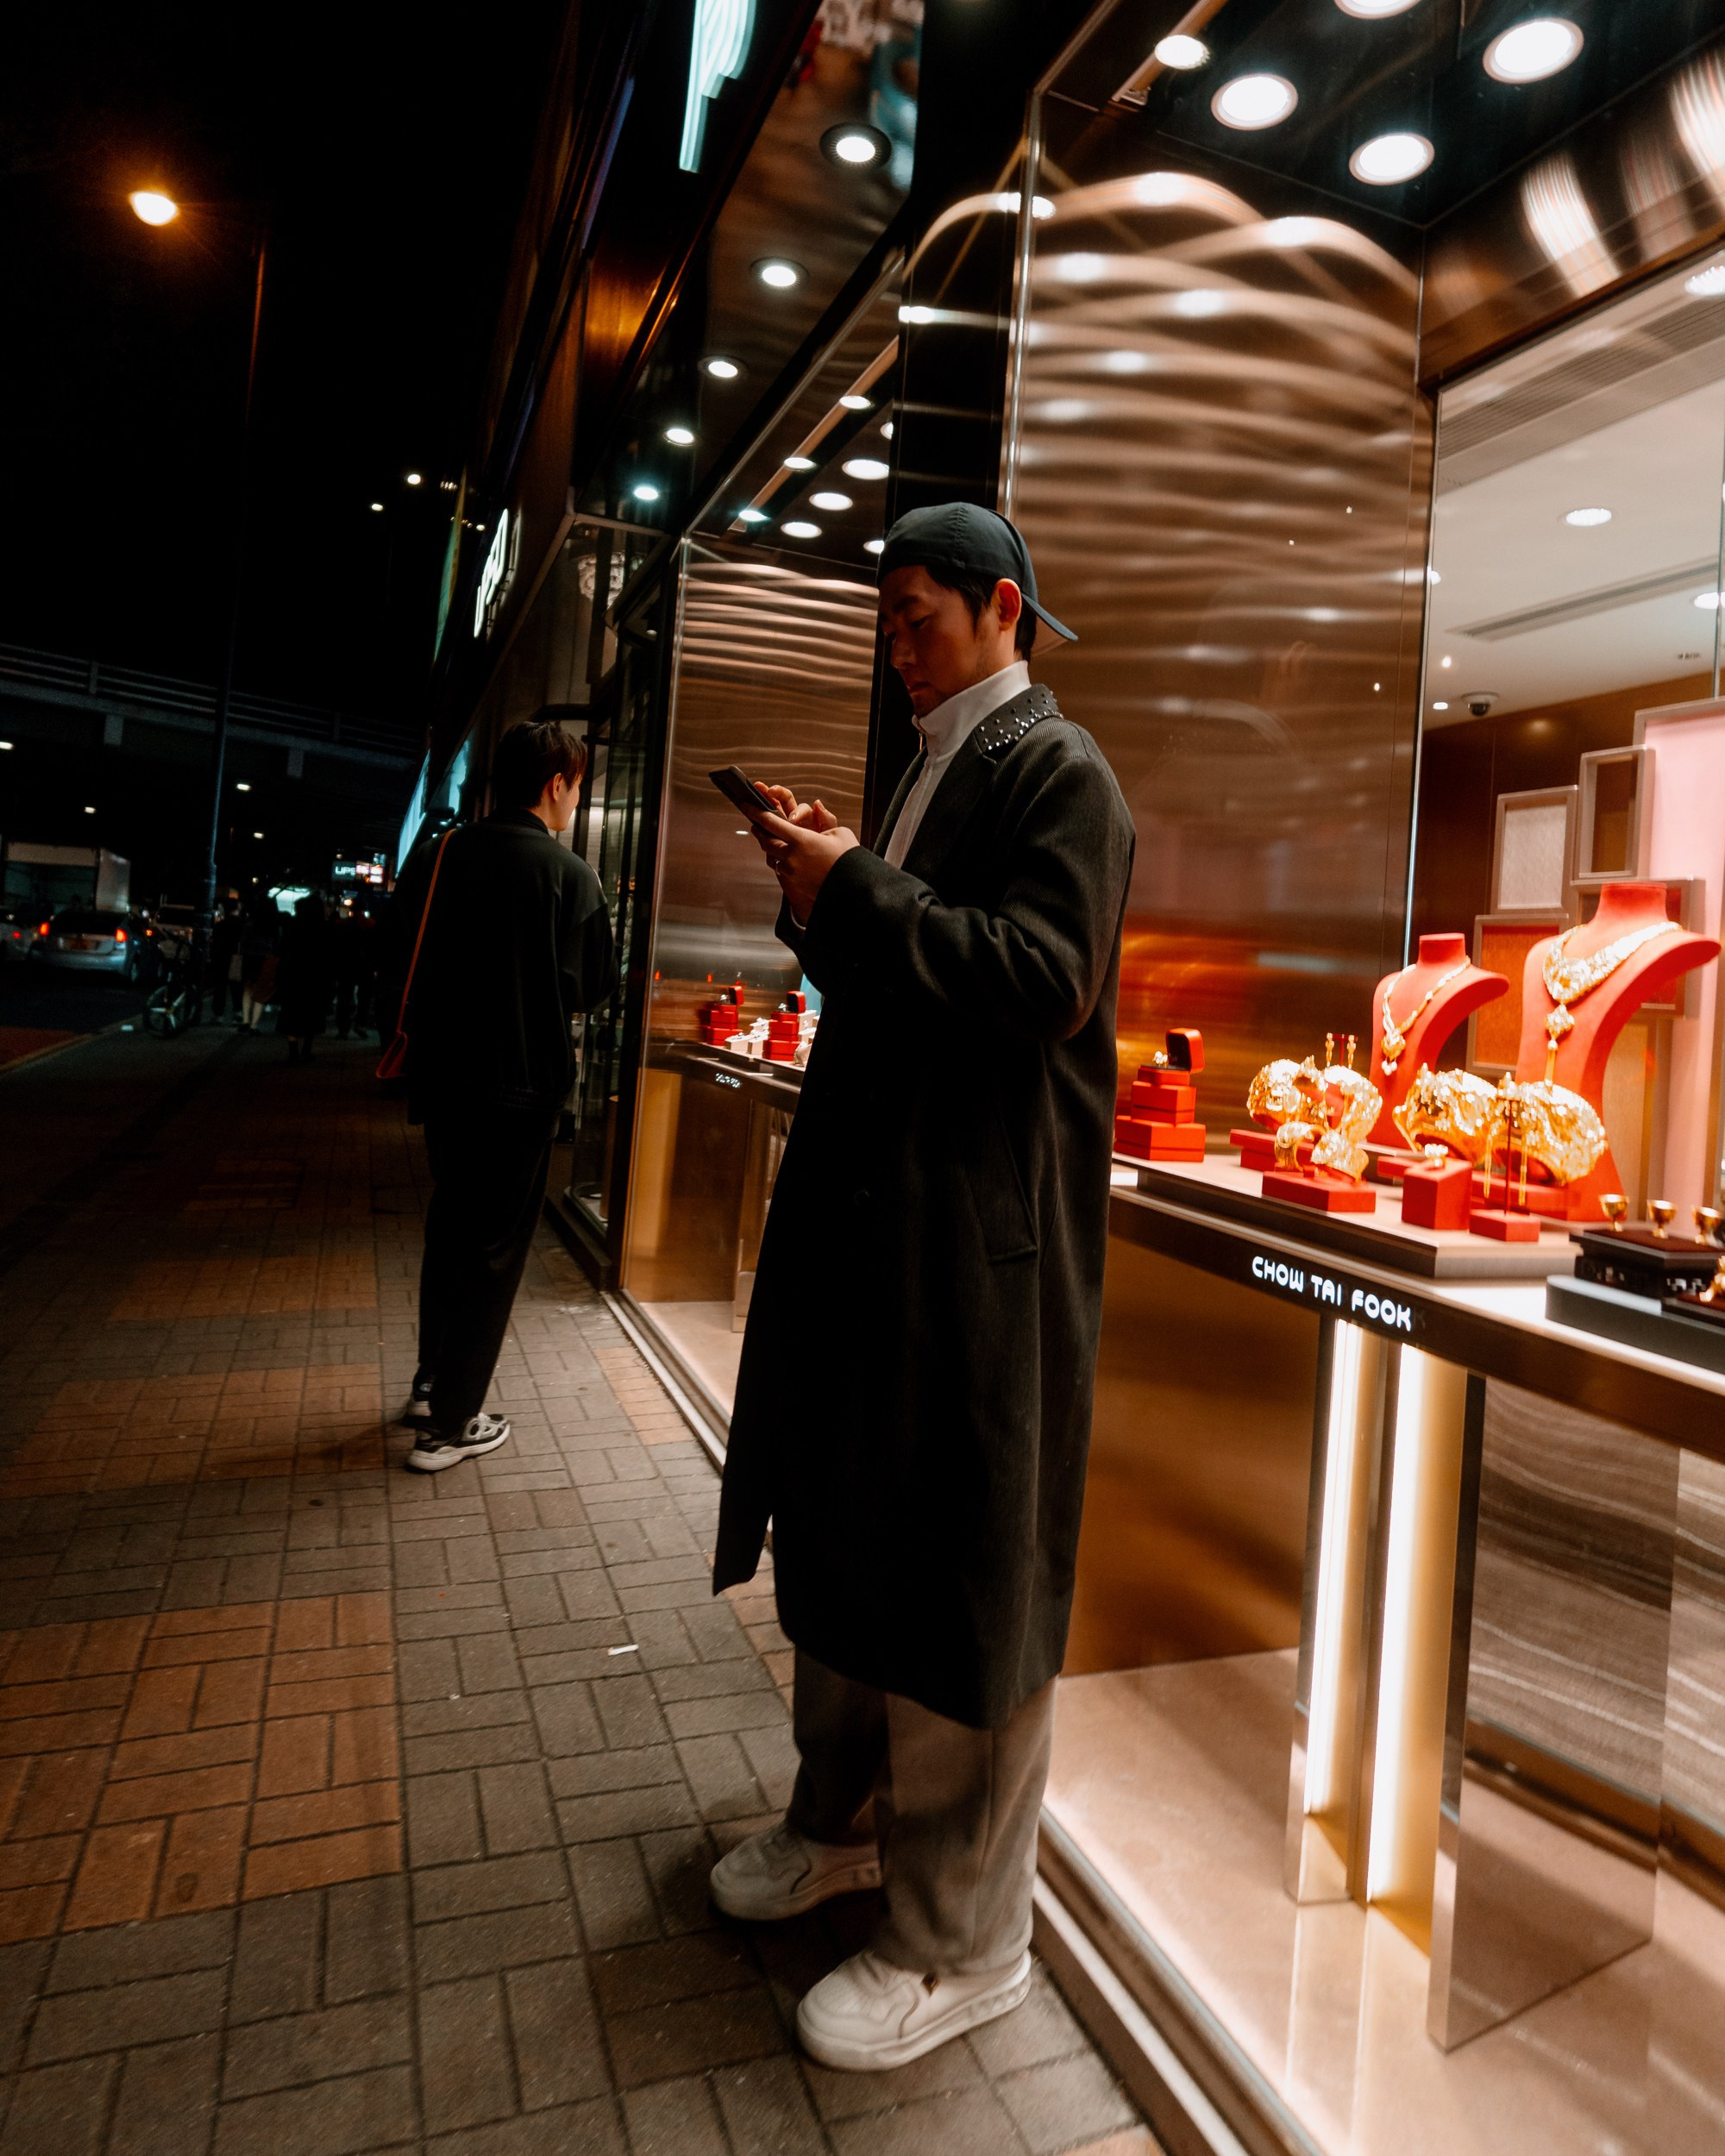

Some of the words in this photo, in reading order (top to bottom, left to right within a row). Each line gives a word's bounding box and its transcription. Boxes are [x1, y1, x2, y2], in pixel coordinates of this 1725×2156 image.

[1251, 1256, 1304, 1293] CHOW
[1310, 1274, 1342, 1307] TAI
[1352, 1288, 1412, 1332] FOOK
